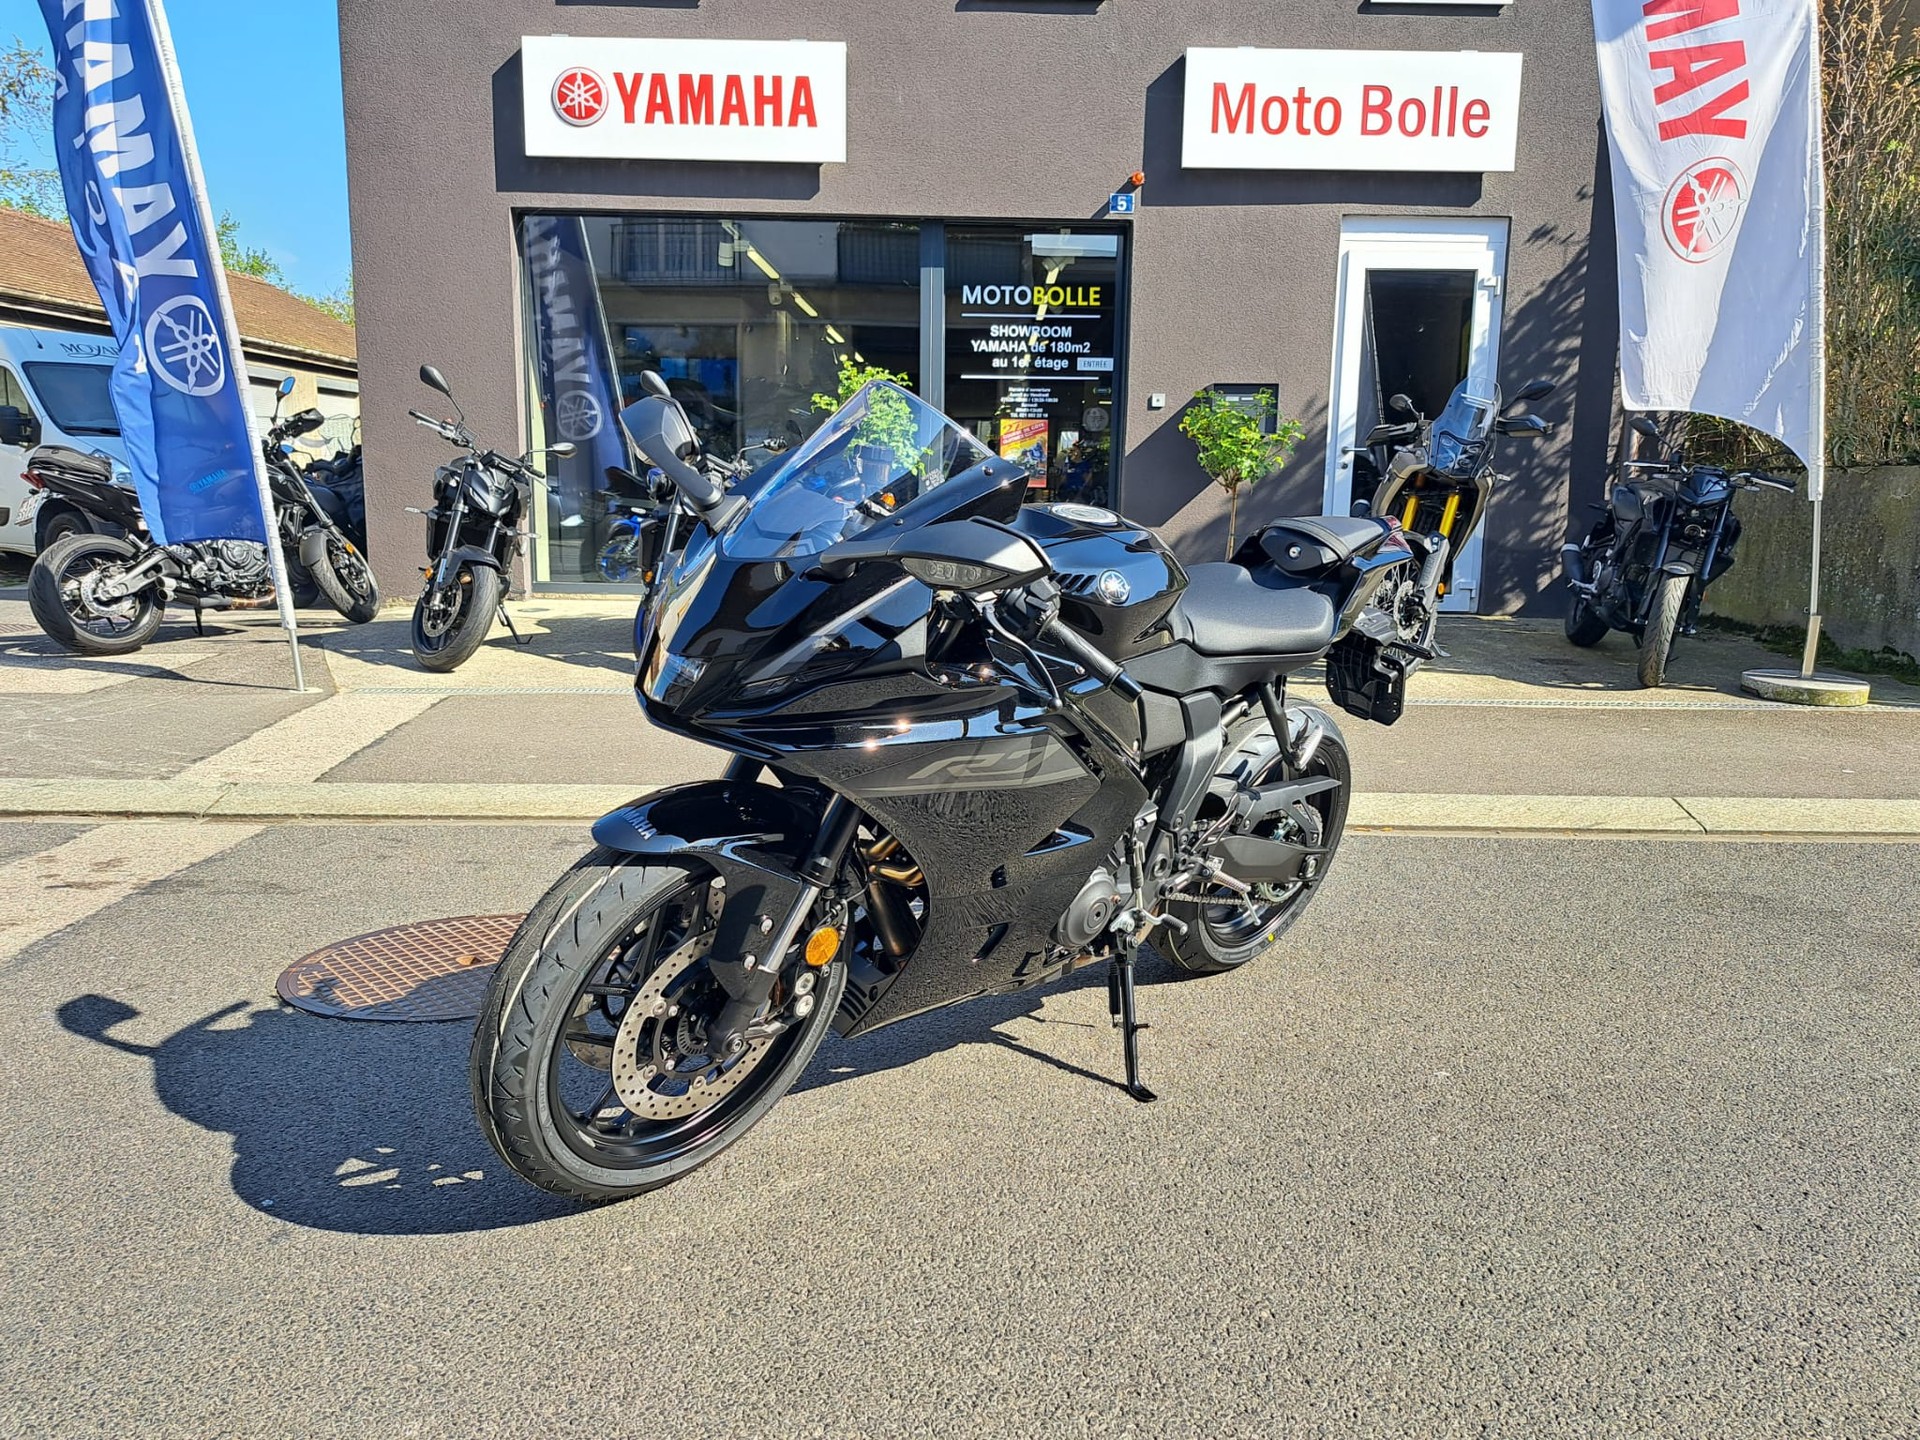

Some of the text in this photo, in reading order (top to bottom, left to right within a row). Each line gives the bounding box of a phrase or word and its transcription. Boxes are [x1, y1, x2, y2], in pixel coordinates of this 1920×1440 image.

[613, 72, 818, 128] YAMAHA
[1210, 82, 1491, 138] Moto Bolle
[1116, 196, 1127, 212] 5
[961, 284, 1101, 307] MOTOBOLLE
[989, 325, 1072, 339] SHOWROOM
[970, 340, 1091, 354] YAMAHA de 180m2
[991, 358, 1008, 368] au
[1034, 356, 1069, 373] étage
